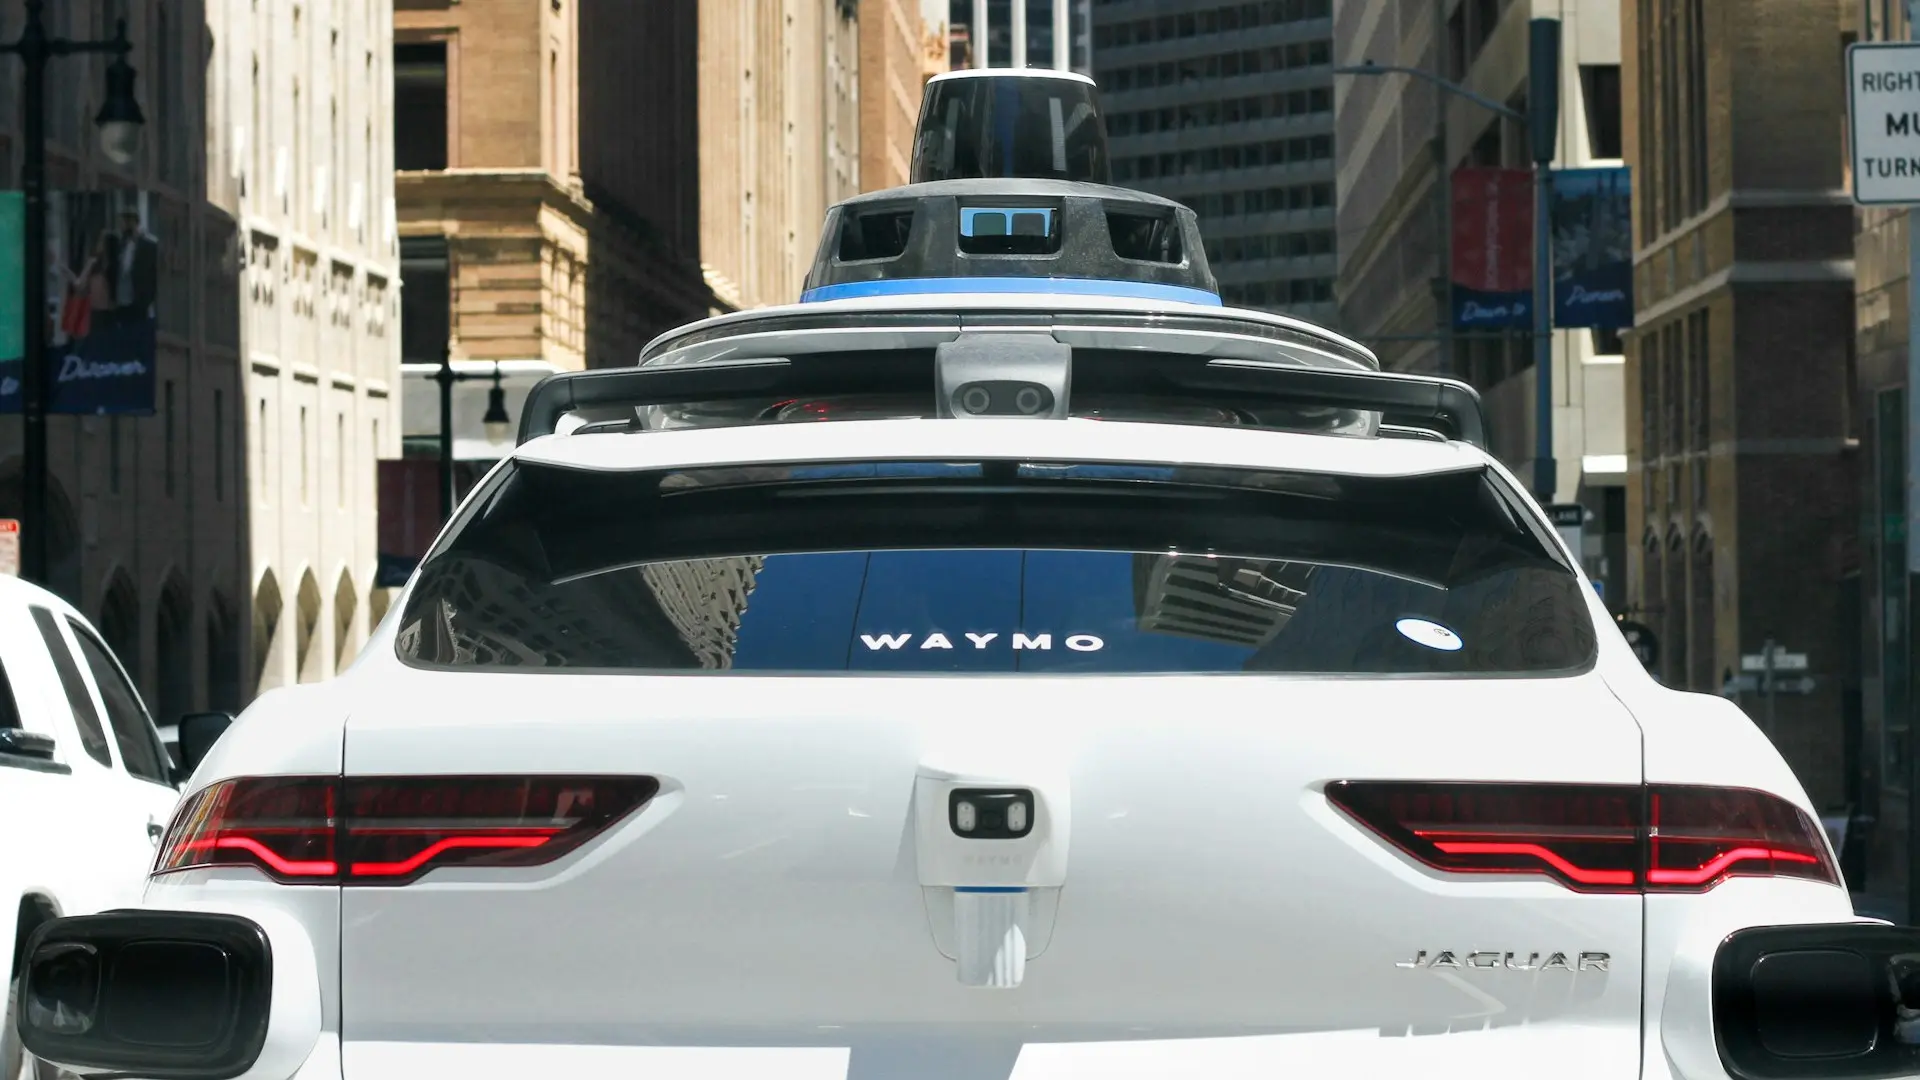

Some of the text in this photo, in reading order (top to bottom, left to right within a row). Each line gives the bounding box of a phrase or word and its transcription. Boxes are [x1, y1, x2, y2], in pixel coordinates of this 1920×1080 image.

[1863, 158, 1920, 178] TURN
[860, 633, 1104, 651] WAYMO
[962, 854, 1024, 866] WAYMO
[1395, 950, 1611, 972] JAGUAR
